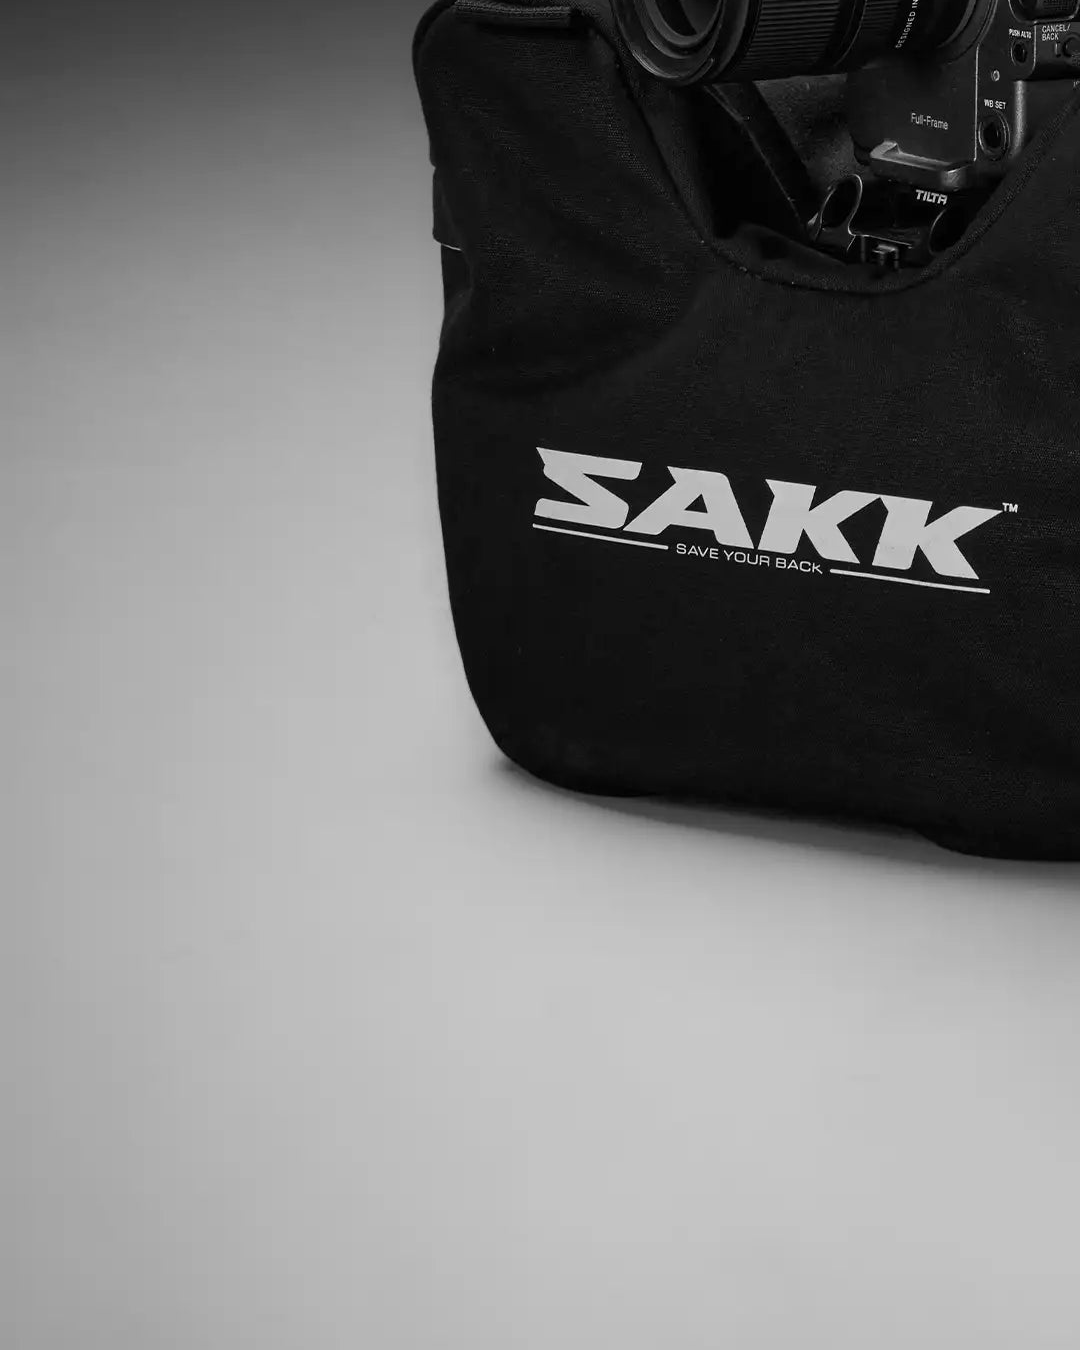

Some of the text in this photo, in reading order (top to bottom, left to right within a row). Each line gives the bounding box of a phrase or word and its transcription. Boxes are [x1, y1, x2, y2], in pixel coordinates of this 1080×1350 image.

[894, 10, 916, 49] DESIGNED
[1042, 24, 1071, 32] CANCEL/
[1042, 33, 1059, 41] BACK
[984, 99, 1007, 110] WB SET
[911, 112, 949, 130] Full-Frame
[915, 189, 948, 205] TILTA
[534, 446, 1019, 580] SAKK TM
[676, 542, 823, 574] SAVE YOUR BACK
